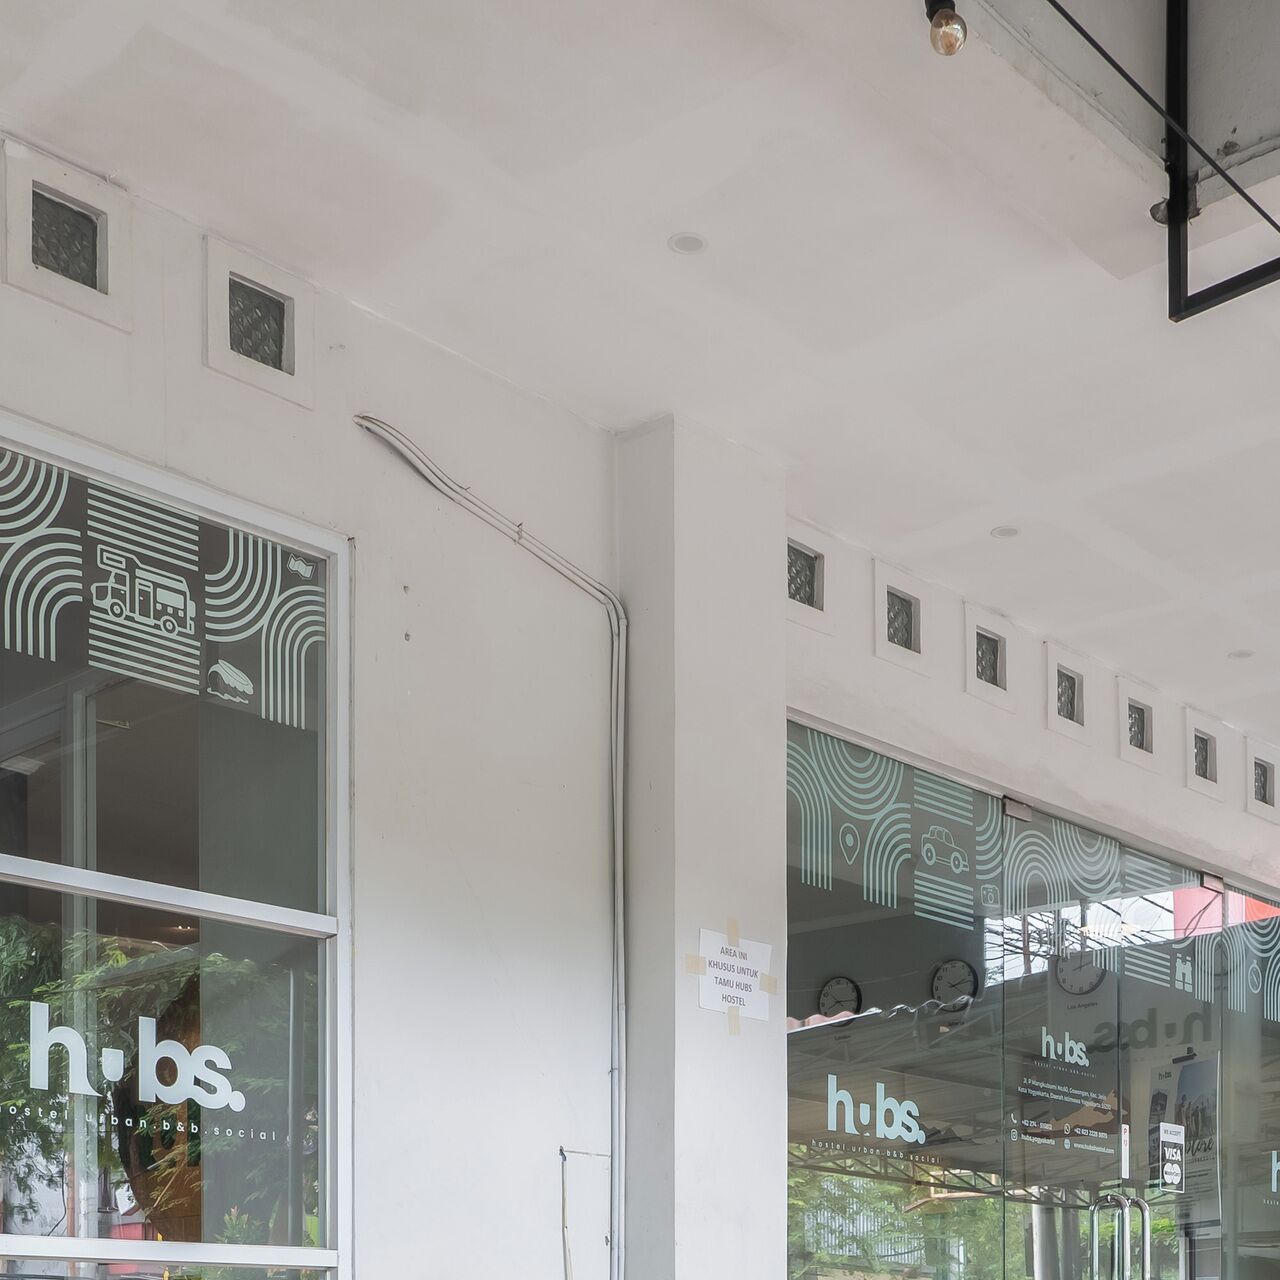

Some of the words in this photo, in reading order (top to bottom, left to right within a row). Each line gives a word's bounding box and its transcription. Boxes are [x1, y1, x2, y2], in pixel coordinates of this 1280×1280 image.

[720, 946, 737, 958] AREA
[738, 951, 748, 960] INI
[708, 959, 736, 973] KHUSUS
[736, 966, 759, 979] UNTUK
[714, 976, 734, 989] TAMU
[735, 982, 753, 993] HUBS
[721, 993, 746, 1007] HOSTEL
[30, 1001, 246, 1112] hubs.
[827, 1073, 927, 1145] hubs.
[1164, 1147, 1182, 1161] VISA
